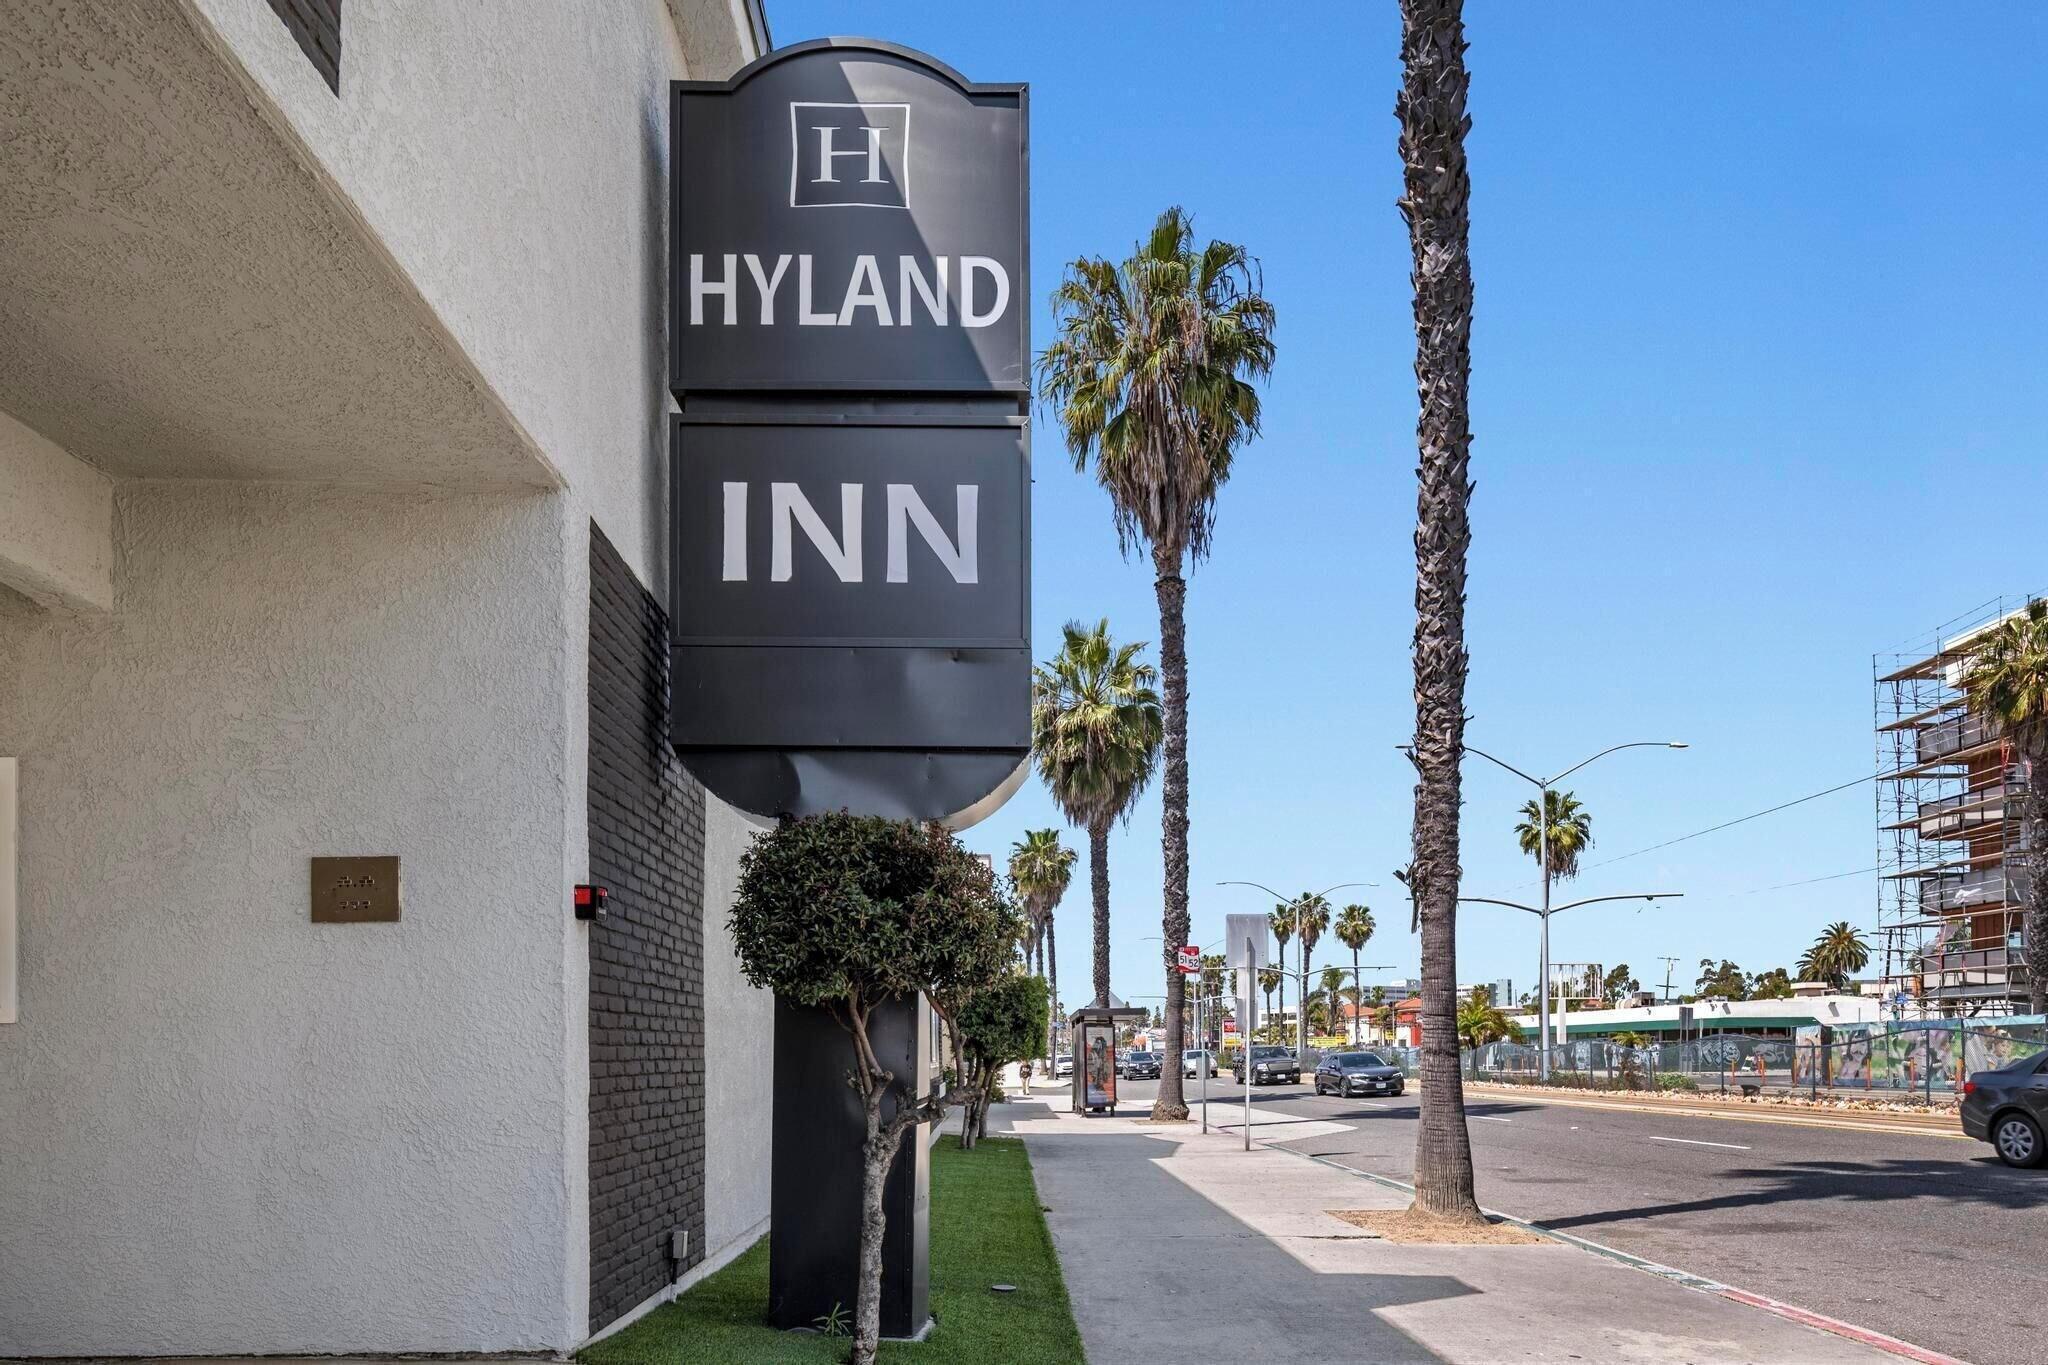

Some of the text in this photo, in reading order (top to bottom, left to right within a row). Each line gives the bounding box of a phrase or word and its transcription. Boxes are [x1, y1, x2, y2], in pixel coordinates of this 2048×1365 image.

[810, 126, 890, 184] H
[690, 253, 1010, 328] HYLAND
[722, 481, 979, 584] INN
[1180, 955, 1199, 968] 51 52
